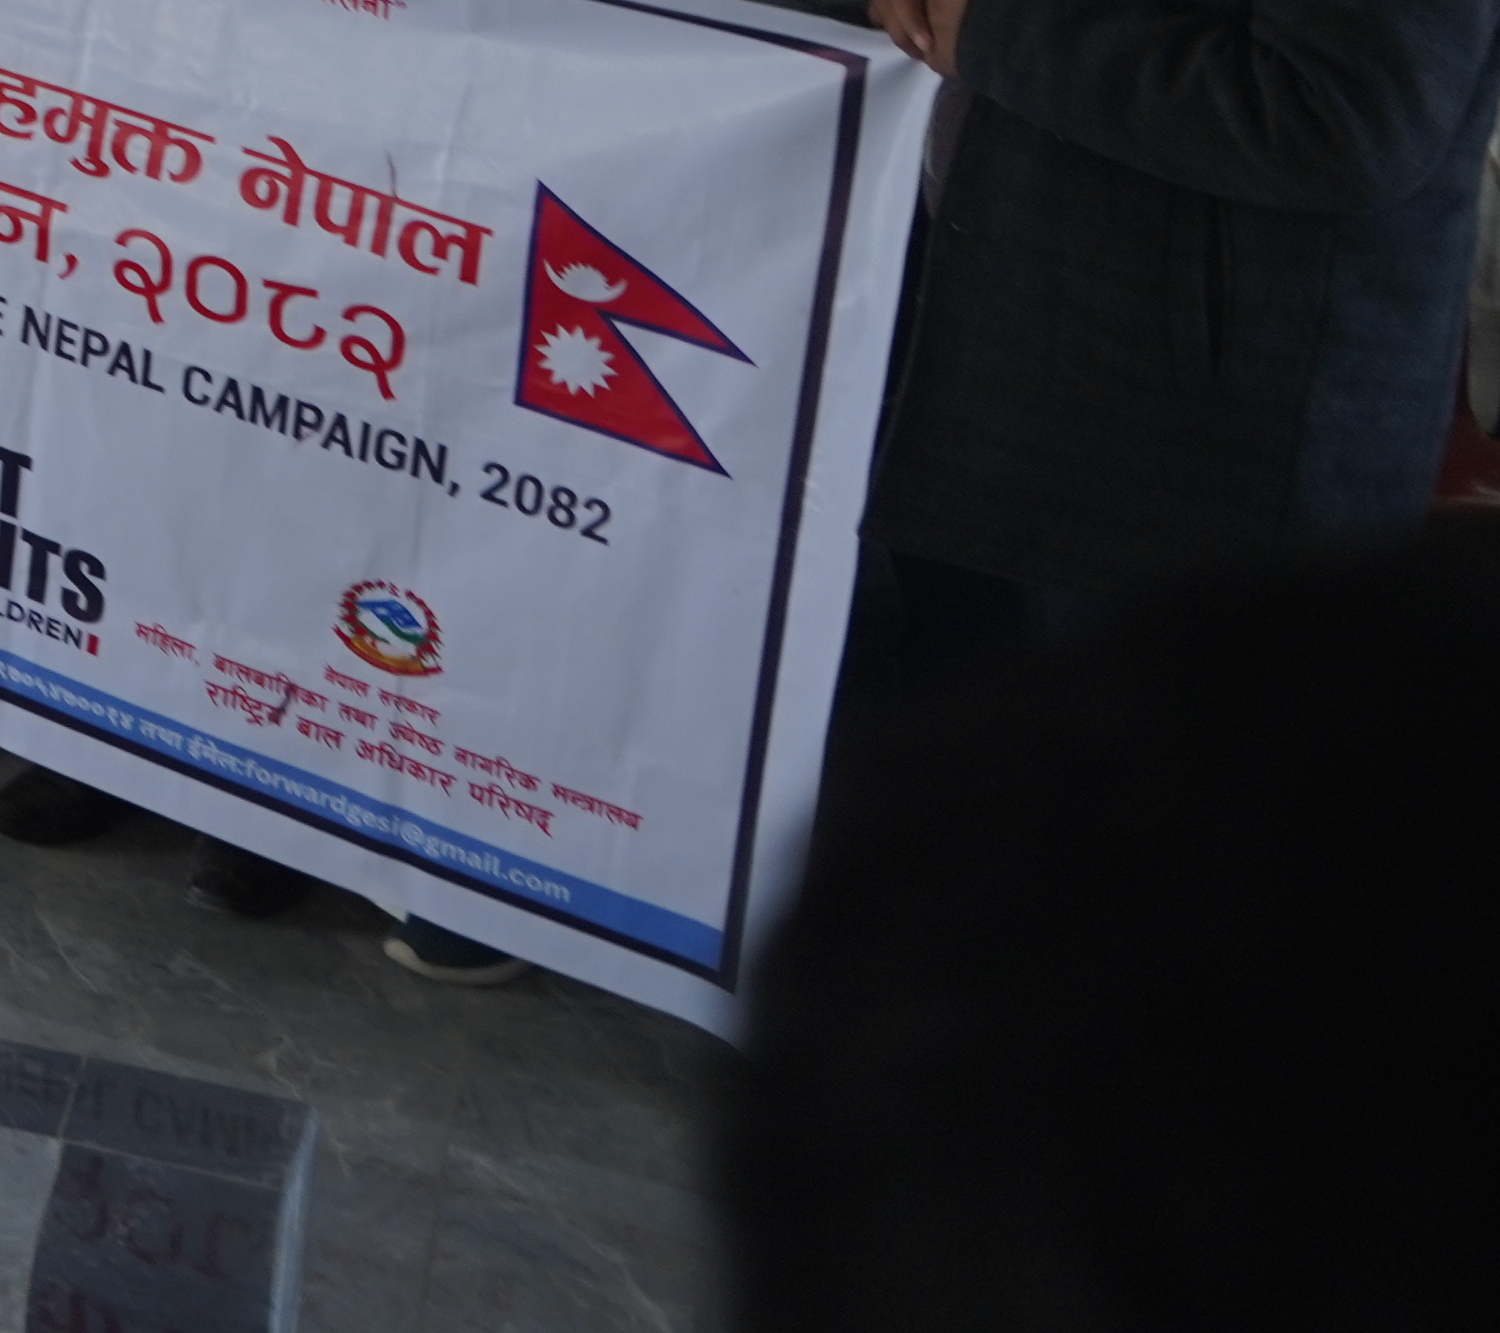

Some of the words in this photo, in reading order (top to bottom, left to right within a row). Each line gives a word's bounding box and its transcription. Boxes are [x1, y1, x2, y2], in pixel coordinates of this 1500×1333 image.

[238, 135, 494, 286] नेपाल
[113, 228, 406, 402] २०८२
[20, 305, 166, 393] NEPAL
[182, 367, 460, 499] CAMPAIGN,
[481, 462, 611, 547] 2082
[297, 714, 344, 750] बाल
